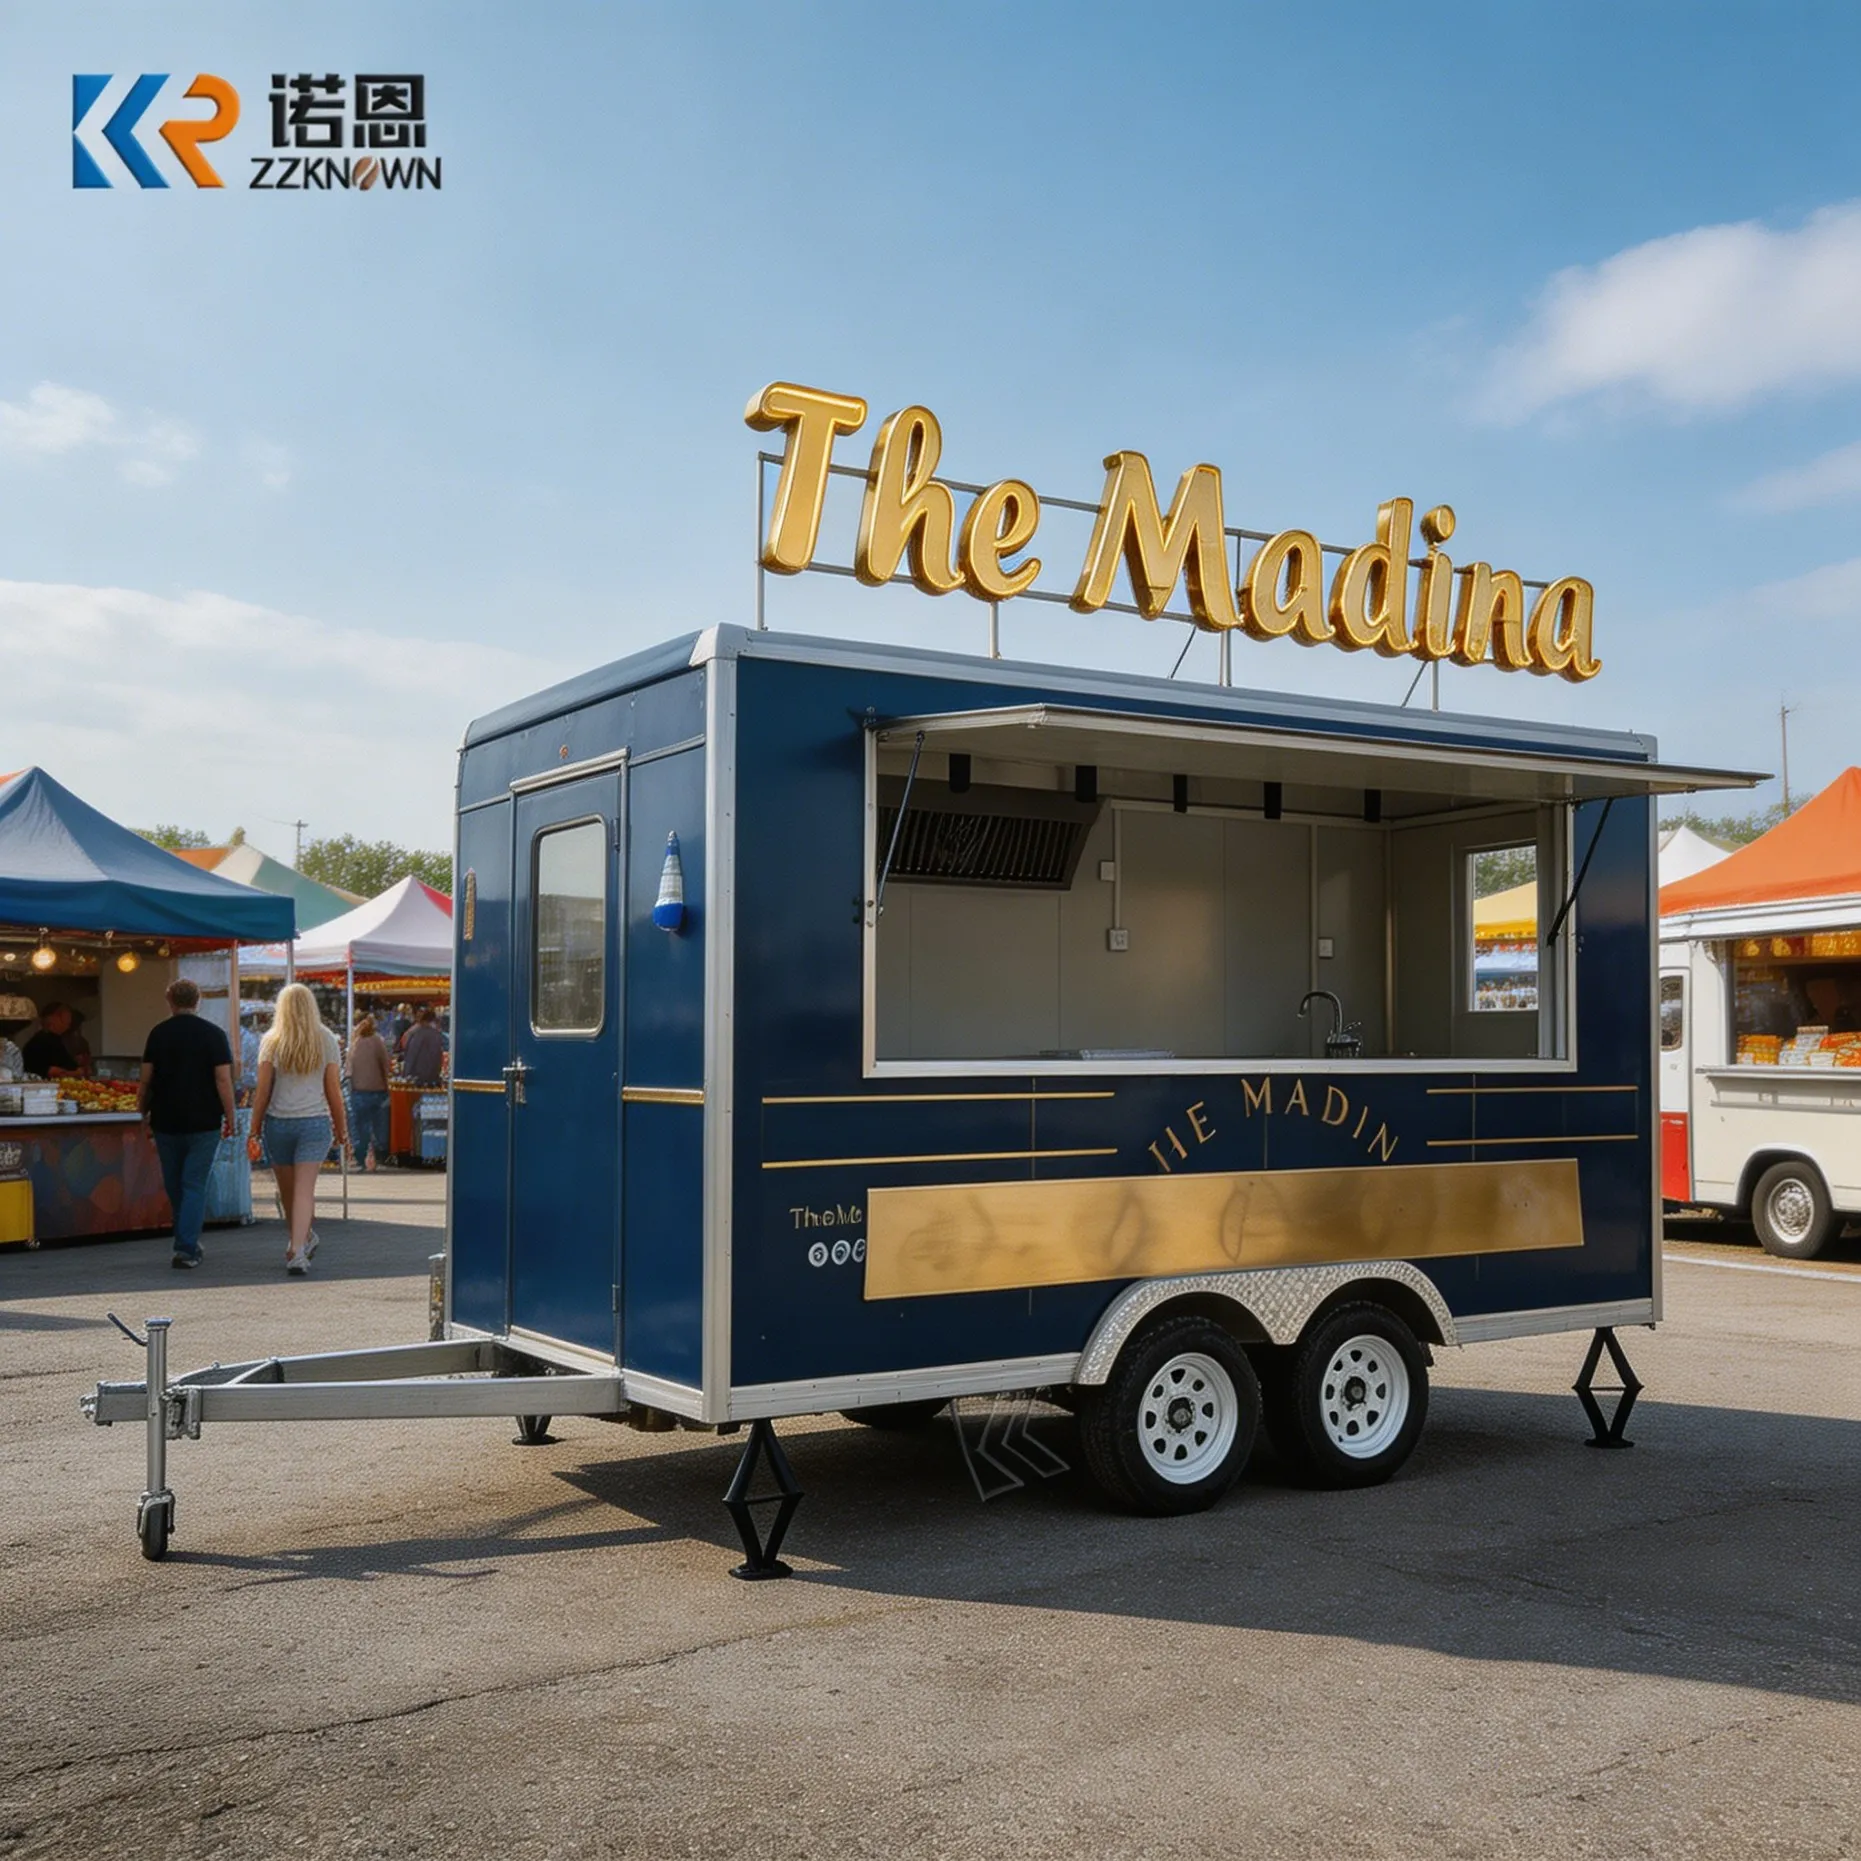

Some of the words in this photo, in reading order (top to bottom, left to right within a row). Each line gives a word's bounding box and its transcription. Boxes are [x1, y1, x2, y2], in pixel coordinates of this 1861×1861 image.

[744, 380, 1041, 601] The
[1069, 450, 1602, 682] Madina
[1241, 1076, 1398, 1162] MADIN
